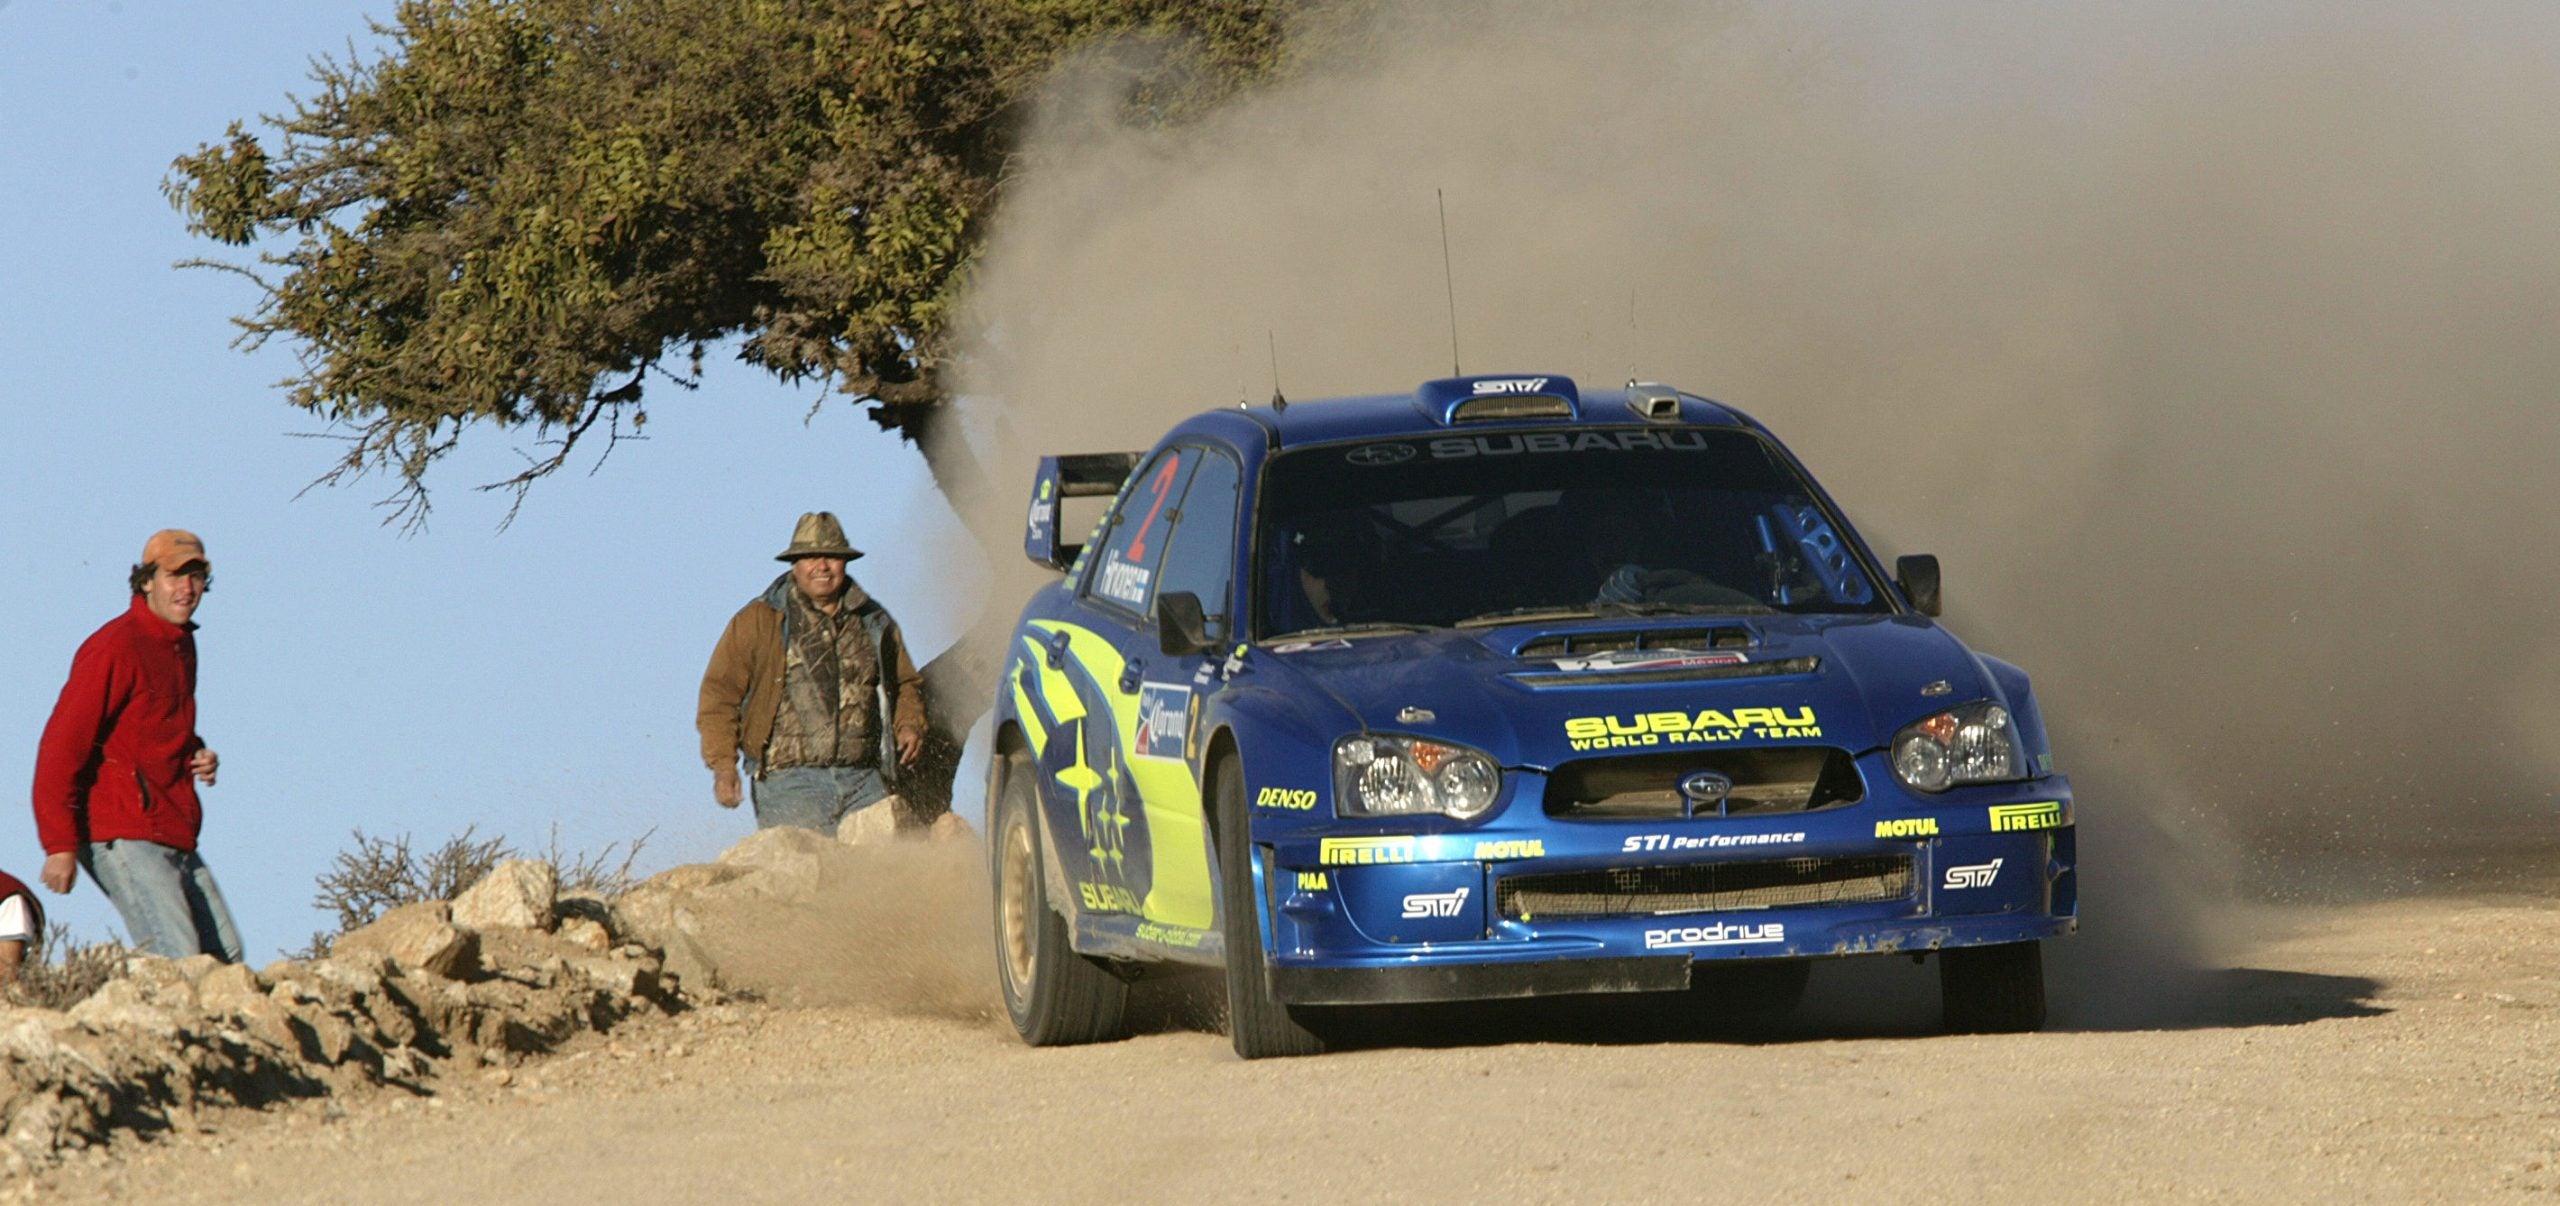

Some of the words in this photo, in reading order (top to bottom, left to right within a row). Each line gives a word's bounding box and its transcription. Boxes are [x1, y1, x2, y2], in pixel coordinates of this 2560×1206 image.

[1429, 431, 1708, 459] SUBARU
[1126, 455, 1180, 563] 2
[1150, 698, 1185, 743] Corona
[1187, 693, 1200, 759] 2
[1565, 706, 1816, 739] SUBARU
[1570, 735, 1658, 751] WORLD
[1669, 729, 1743, 744] RALLY
[1754, 727, 1822, 739] TEAM
[1257, 787, 1317, 811] DENSO
[1875, 818, 1939, 838] MOTUL
[1991, 801, 2062, 832] PIRELLI
[1320, 835, 1415, 865] PIRELLI
[1475, 839, 1546, 860] MOTUL
[1622, 834, 1671, 852] STI
[1672, 831, 1806, 850] Performance
[1298, 872, 1329, 891] PIAA
[1079, 881, 1144, 917] SUBARU
[1645, 921, 1784, 950] prodrive
